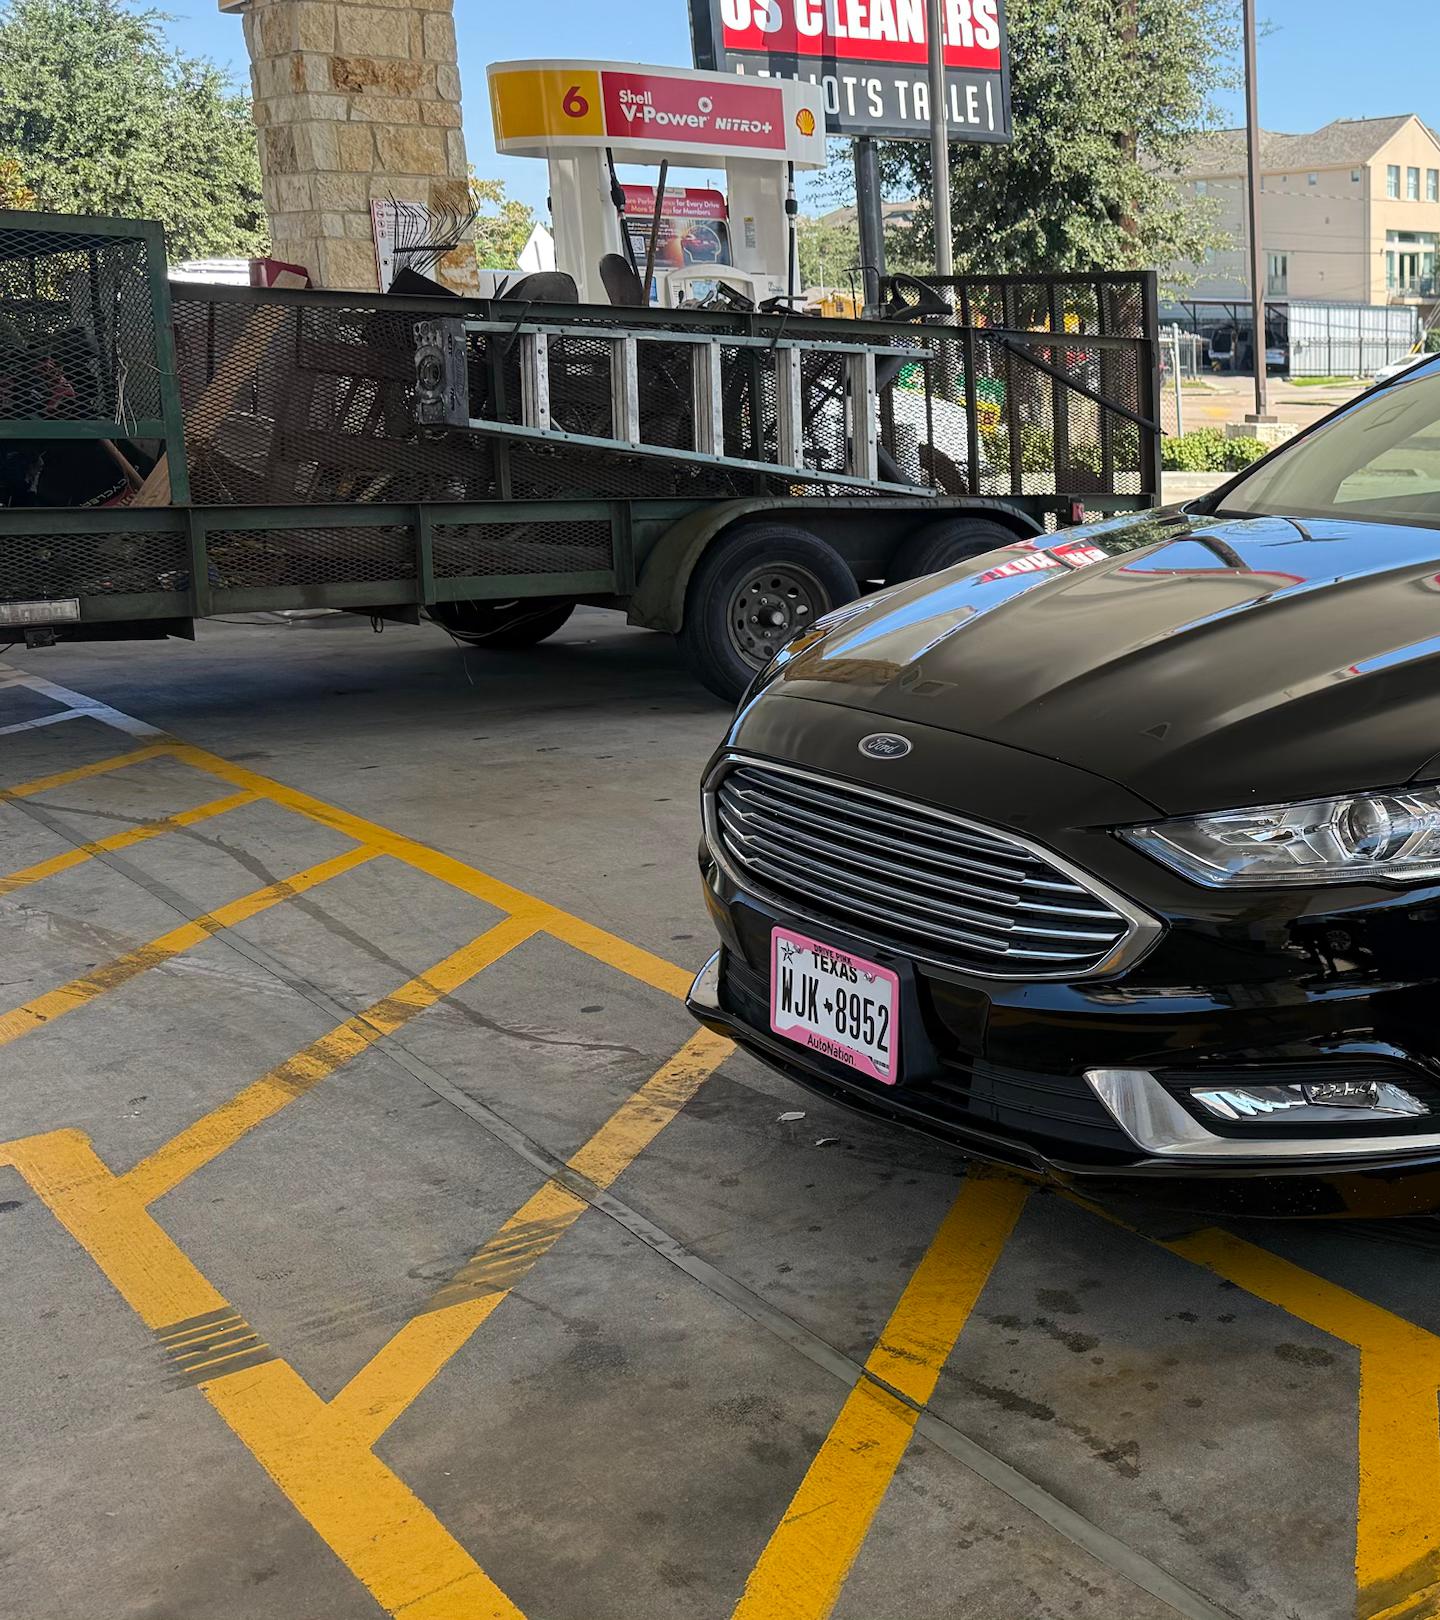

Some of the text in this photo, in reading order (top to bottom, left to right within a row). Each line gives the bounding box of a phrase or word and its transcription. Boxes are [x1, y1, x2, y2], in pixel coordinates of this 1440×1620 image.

[795, 0, 1000, 49] CLEANRS
[562, 86, 589, 118] 6
[619, 89, 652, 105] Shell
[894, 80, 980, 124] TALE
[620, 103, 707, 128] V-Power
[811, 952, 858, 984] TEXAS
[807, 1034, 854, 1066] AutoNation
